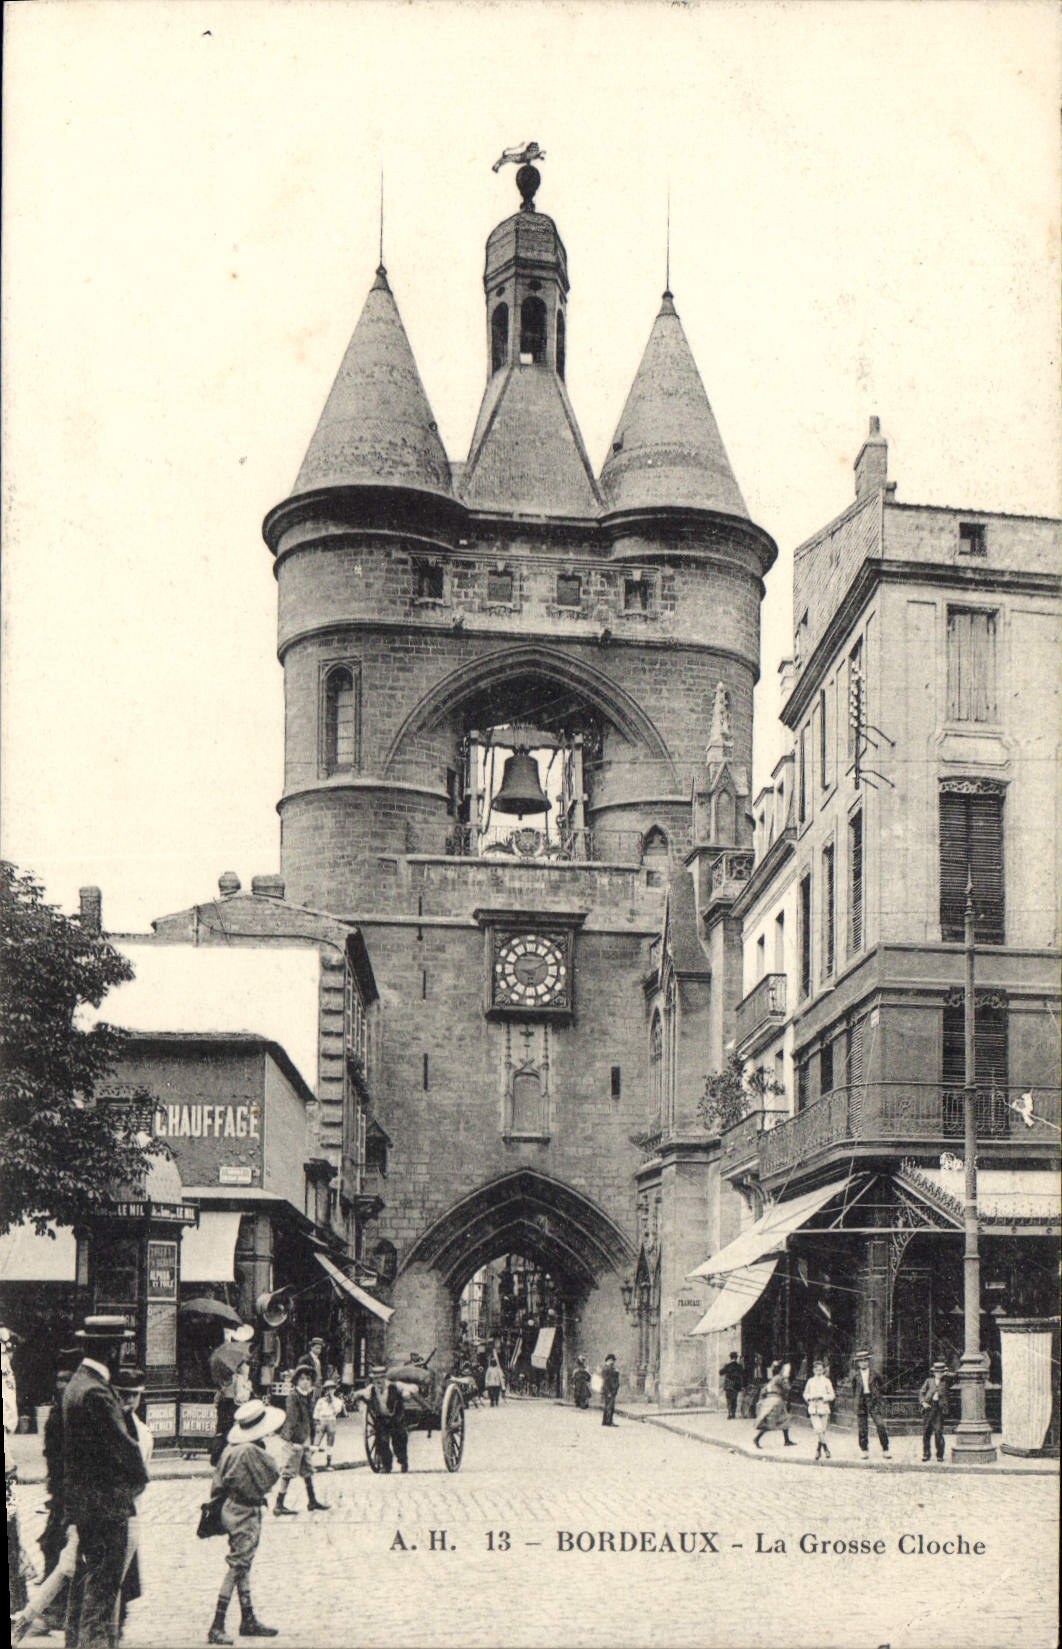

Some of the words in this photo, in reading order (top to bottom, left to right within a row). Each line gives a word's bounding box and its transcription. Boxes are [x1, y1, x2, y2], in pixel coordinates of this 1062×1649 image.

[155, 1104, 260, 1138] CHAUFFAGE
[118, 1204, 128, 1216] LE
[129, 1204, 145, 1216] NIL
